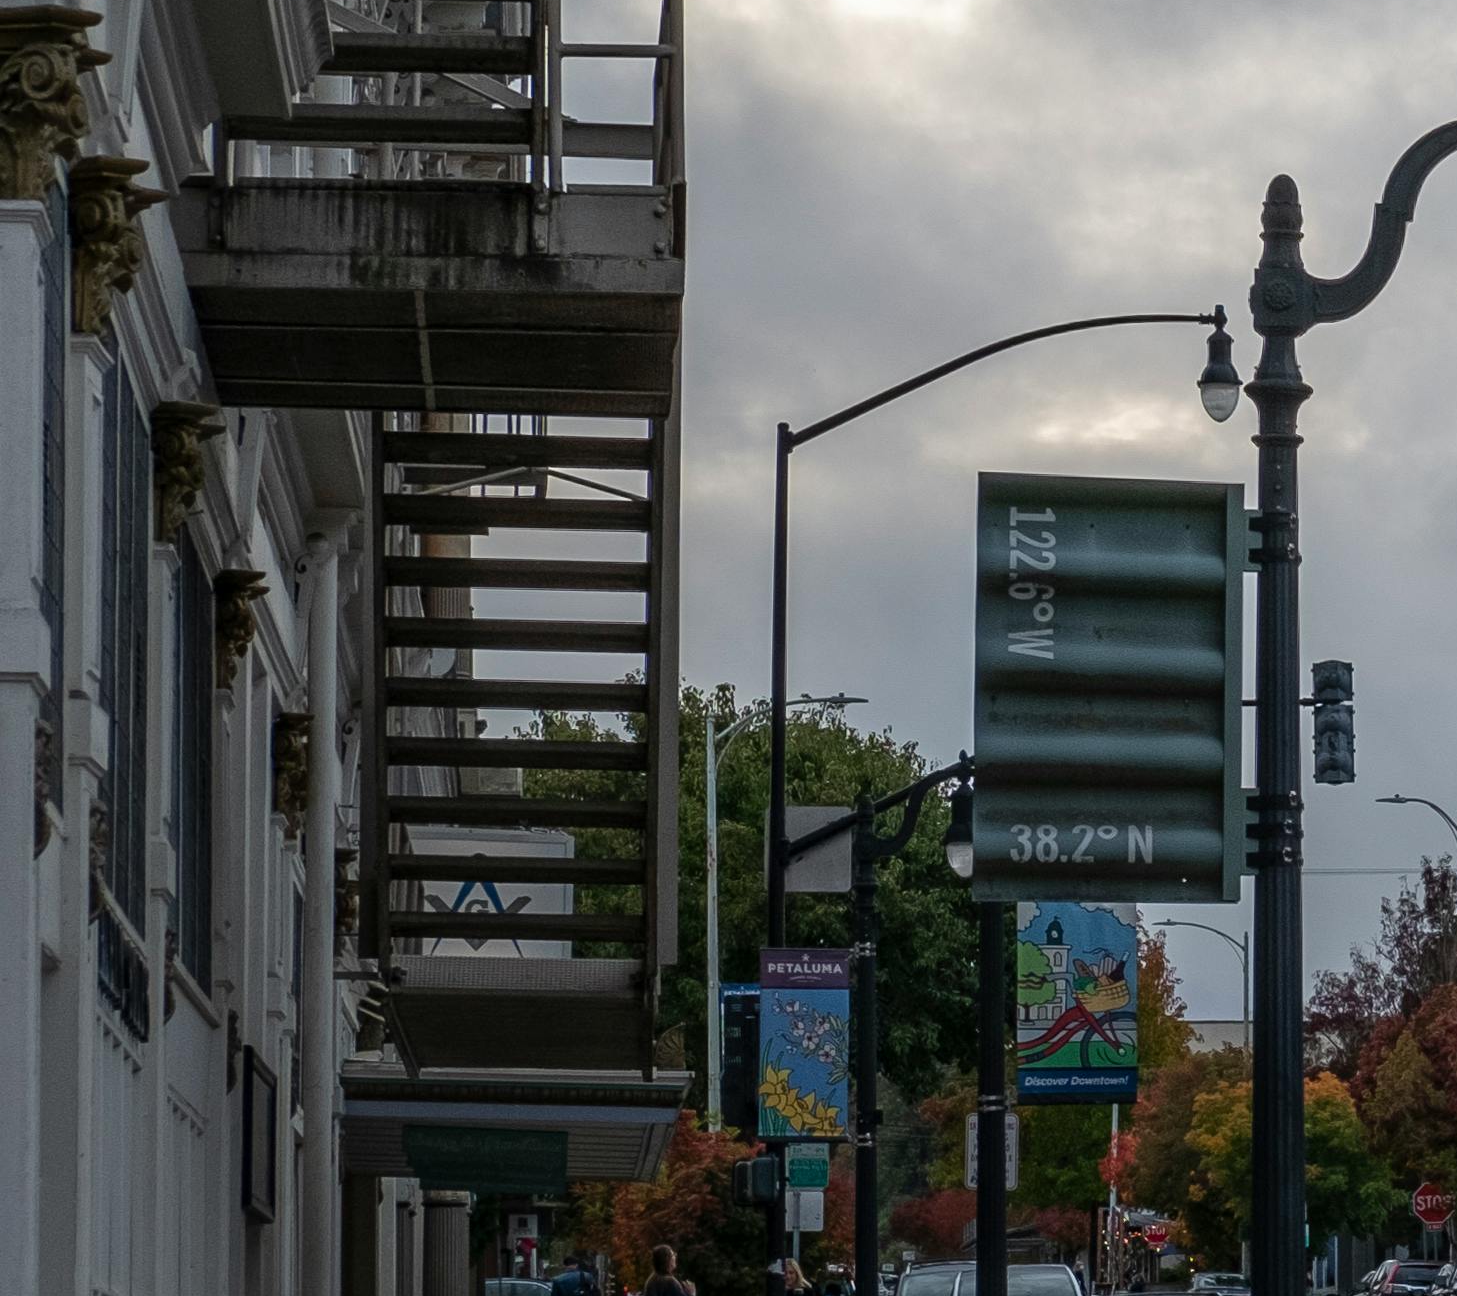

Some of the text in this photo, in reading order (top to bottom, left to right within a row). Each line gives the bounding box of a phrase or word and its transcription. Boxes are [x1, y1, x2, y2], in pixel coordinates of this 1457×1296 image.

[767, 962, 843, 974] PETALUMA
[1024, 1075, 1129, 1088] Discover Downtown!
